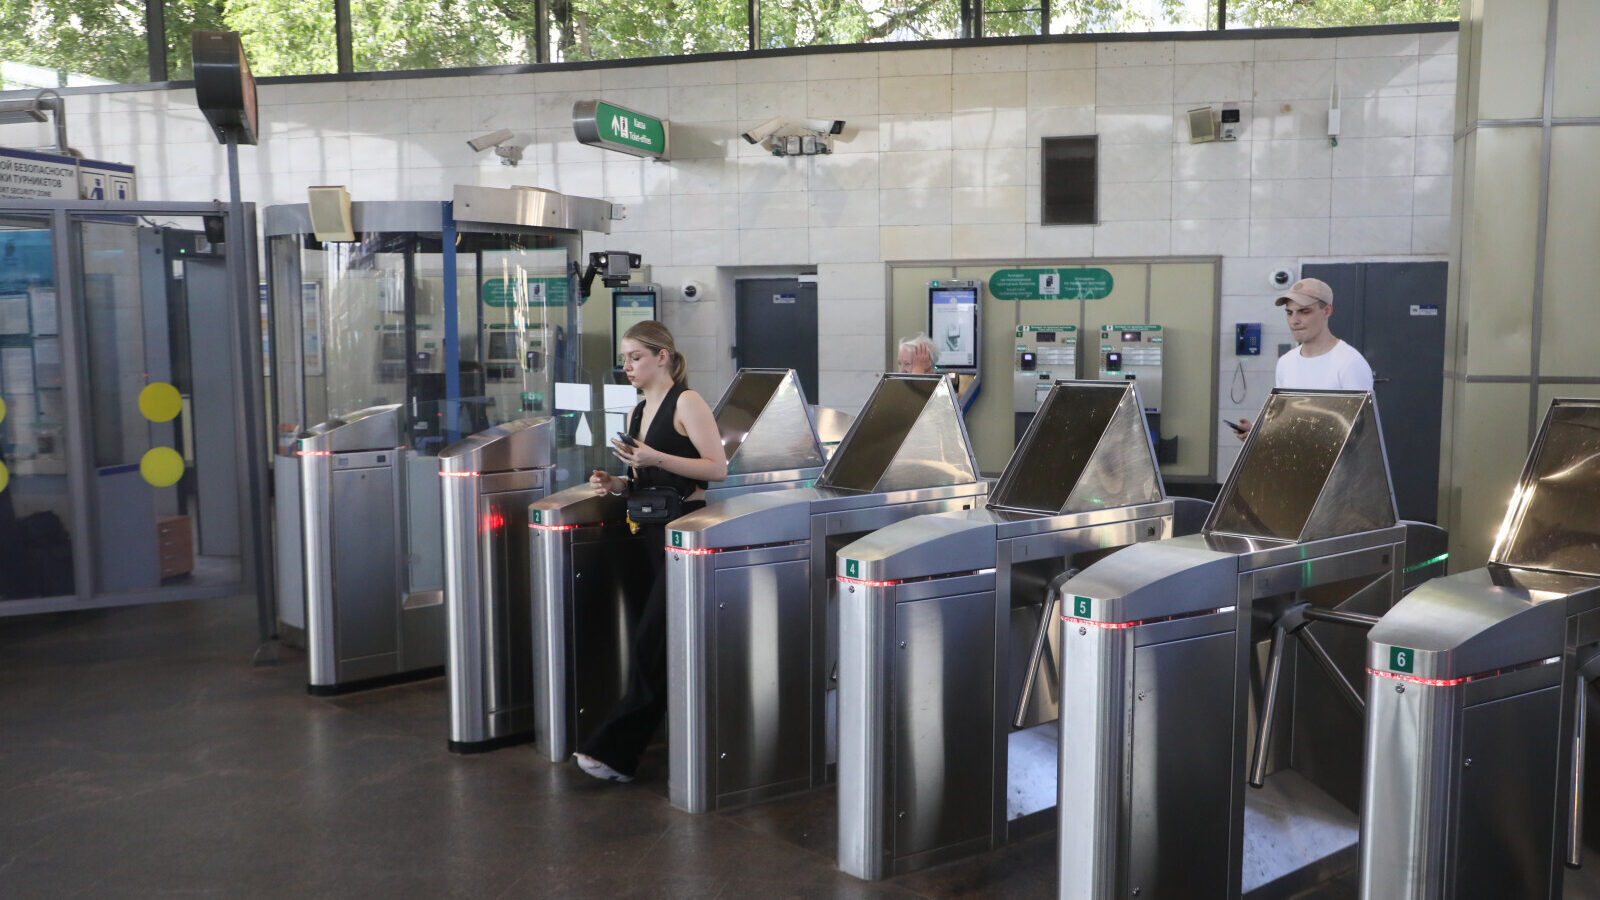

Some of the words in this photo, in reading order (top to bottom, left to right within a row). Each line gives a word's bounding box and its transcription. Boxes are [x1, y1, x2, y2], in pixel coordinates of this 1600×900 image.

[14, 162, 74, 177] БЕЗОПАСНОСТИ
[13, 174, 63, 188] ТУРНИКЕТОВ
[535, 512, 540, 522] 2
[674, 534, 680, 545] 3
[849, 564, 856, 575] 4
[1079, 601, 1087, 614] 5
[1397, 652, 1406, 667] 6
